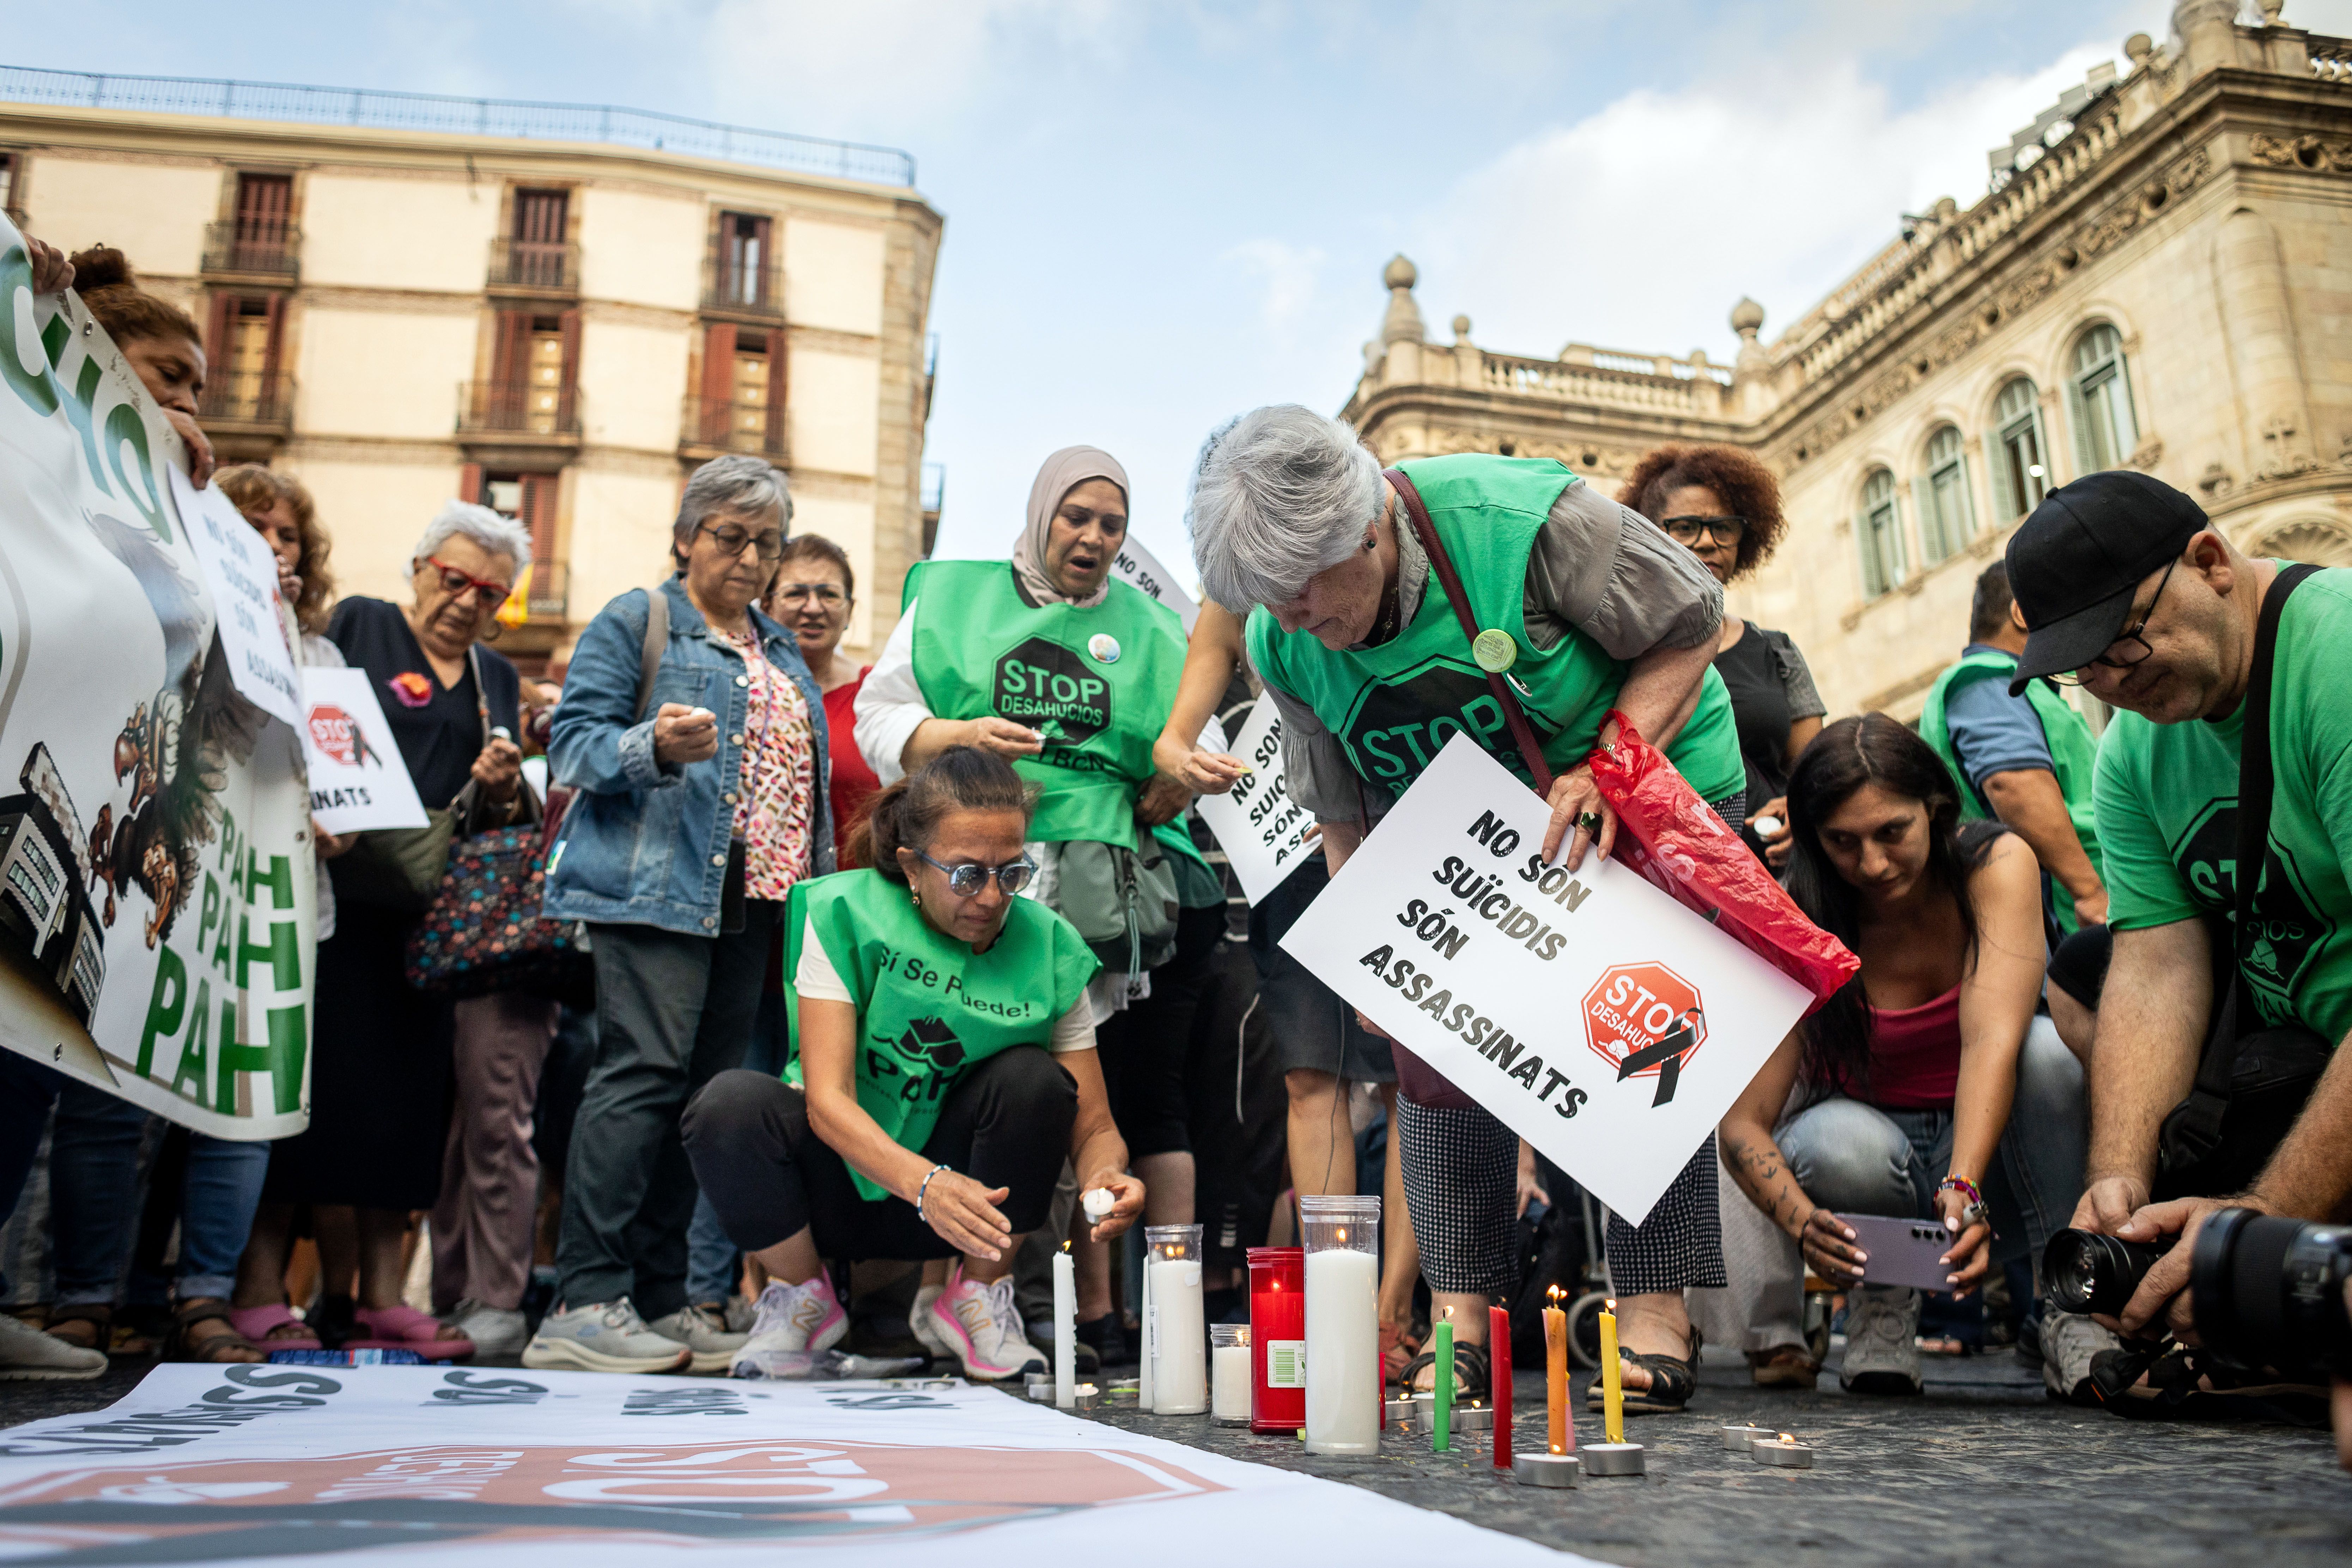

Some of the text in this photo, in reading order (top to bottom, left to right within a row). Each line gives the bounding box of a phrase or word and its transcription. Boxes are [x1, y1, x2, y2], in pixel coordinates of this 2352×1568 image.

[1114, 552, 1136, 574] NO
[1001, 694, 1103, 727] DESAHUCIOS
[1002, 659, 1104, 704] STOP
[311, 718, 354, 741] STO
[1230, 774, 1256, 806] NO
[1263, 804, 1303, 847] SÓN
[1467, 809, 1520, 857] NO
[219, 808, 295, 910] PAH
[197, 869, 302, 992] PAH
[1397, 899, 1470, 961] SÓN
[1433, 856, 1567, 961] SUÏCIDIS
[904, 958, 938, 987] Se
[945, 975, 1030, 1017] Puede!
[1605, 975, 1694, 1034] STO
[135, 942, 307, 1116] PAH
[1359, 944, 1588, 1119] ASSASSINATS
[541, 1447, 915, 1522] STO
